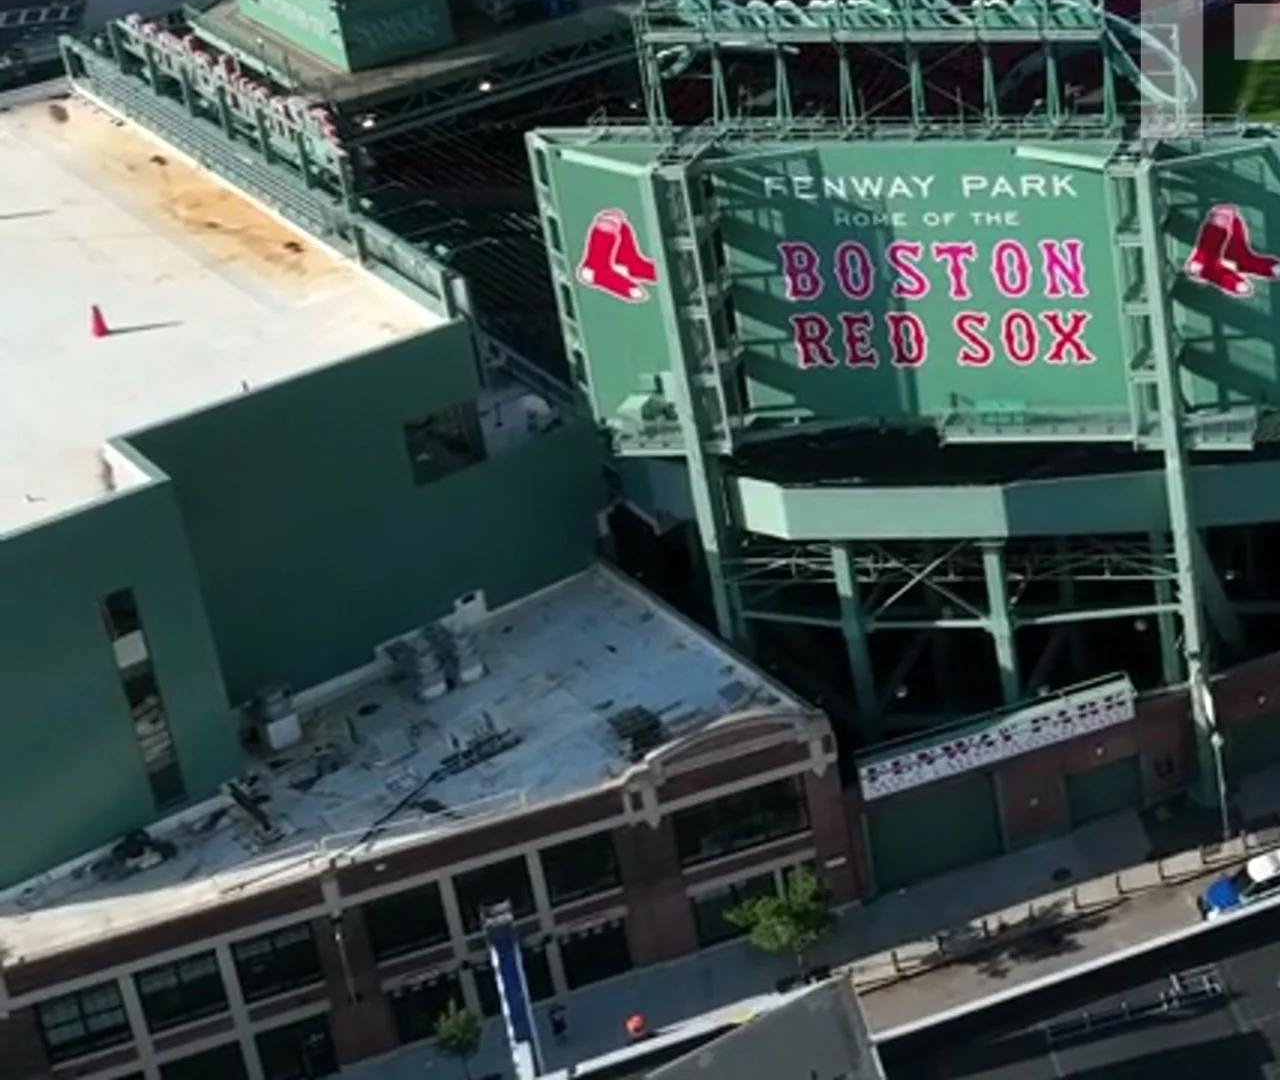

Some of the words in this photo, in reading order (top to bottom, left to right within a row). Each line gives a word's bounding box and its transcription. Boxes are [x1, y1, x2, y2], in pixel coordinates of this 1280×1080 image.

[764, 175, 936, 201] FENWAY
[962, 174, 1078, 197] PARK
[834, 210, 906, 227] HOME
[923, 211, 959, 226] OF
[971, 210, 1020, 225] THE
[778, 240, 1088, 302] BOSTON
[793, 310, 928, 370] RED
[953, 310, 1096, 365] SOX
